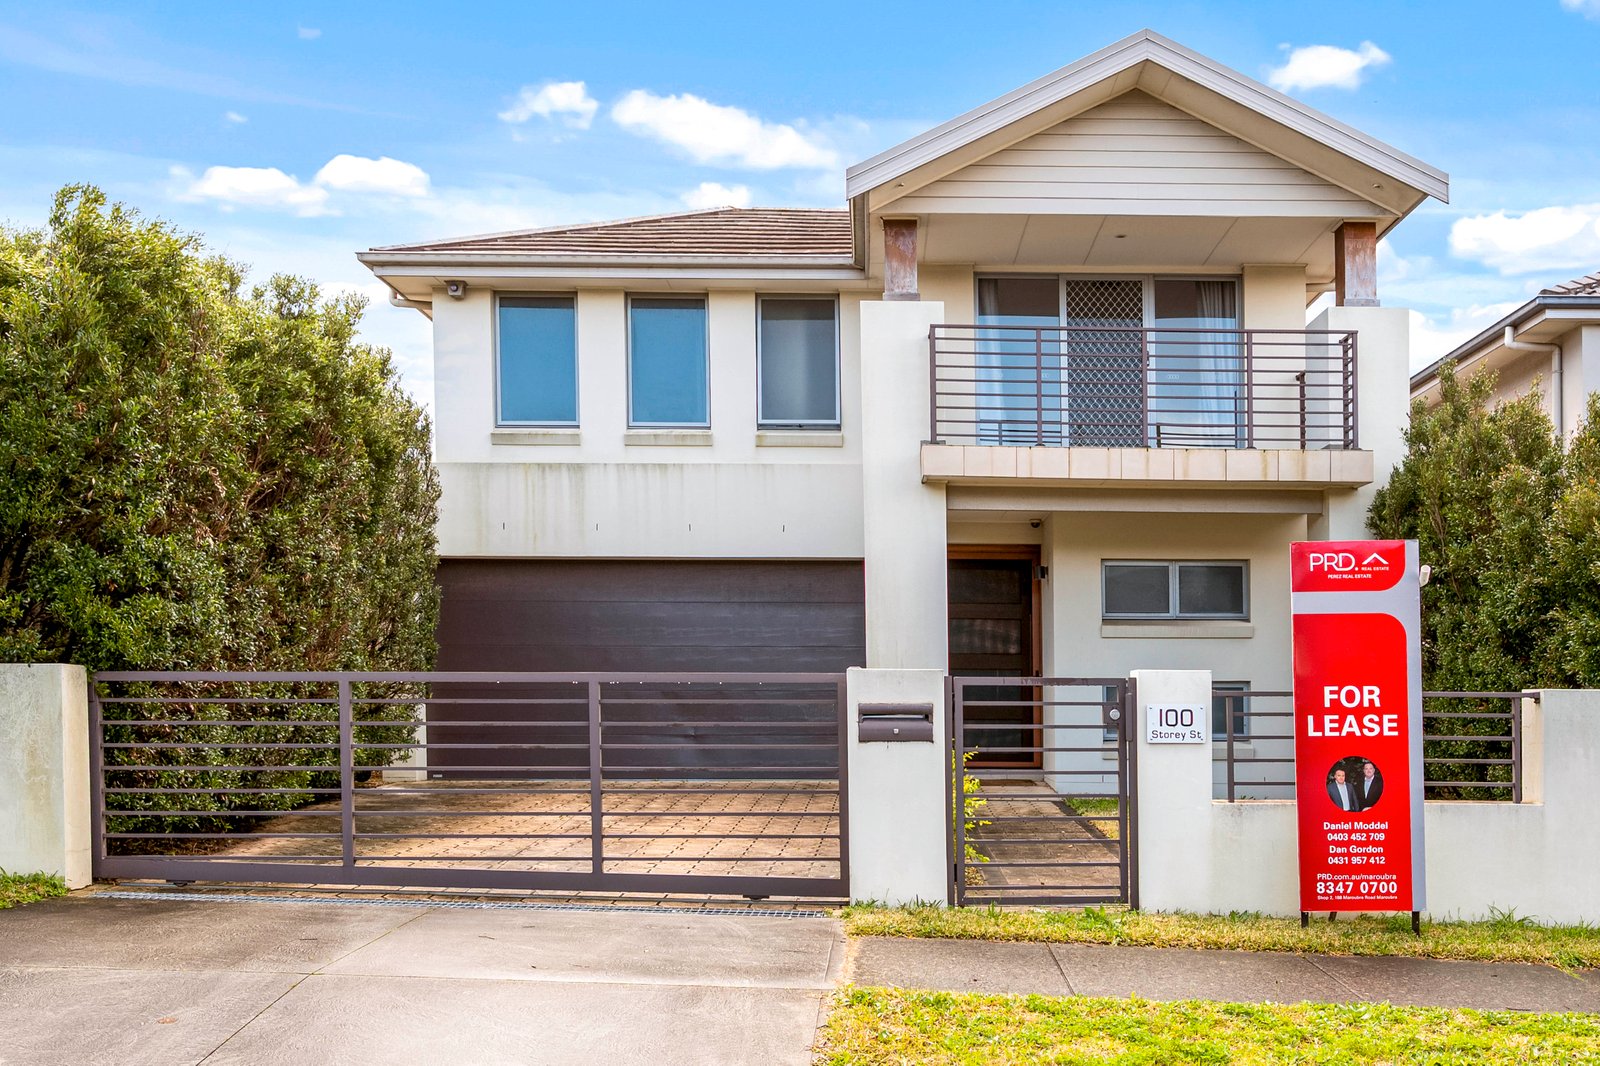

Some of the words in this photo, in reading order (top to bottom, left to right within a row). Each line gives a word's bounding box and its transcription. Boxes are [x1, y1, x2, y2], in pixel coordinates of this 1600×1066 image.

[1324, 685, 1381, 708] FOR
[1159, 708, 1193, 727] 100
[1307, 714, 1399, 737] LEASE
[1152, 729, 1186, 741] Storey
[1190, 729, 1201, 739] St
[1323, 821, 1352, 830] Daniel
[1354, 821, 1389, 830] Moddel
[1327, 832, 1348, 841] 0403
[1350, 832, 1367, 841] 452
[1369, 832, 1385, 841] 709
[1329, 845, 1347, 853] Dan
[1349, 845, 1384, 853] Gordon
[1328, 856, 1349, 865] 0431
[1351, 856, 1367, 865] 957
[1369, 856, 1386, 865] 412
[1316, 881, 1354, 894] 8347
[1360, 881, 1398, 893] 0700
